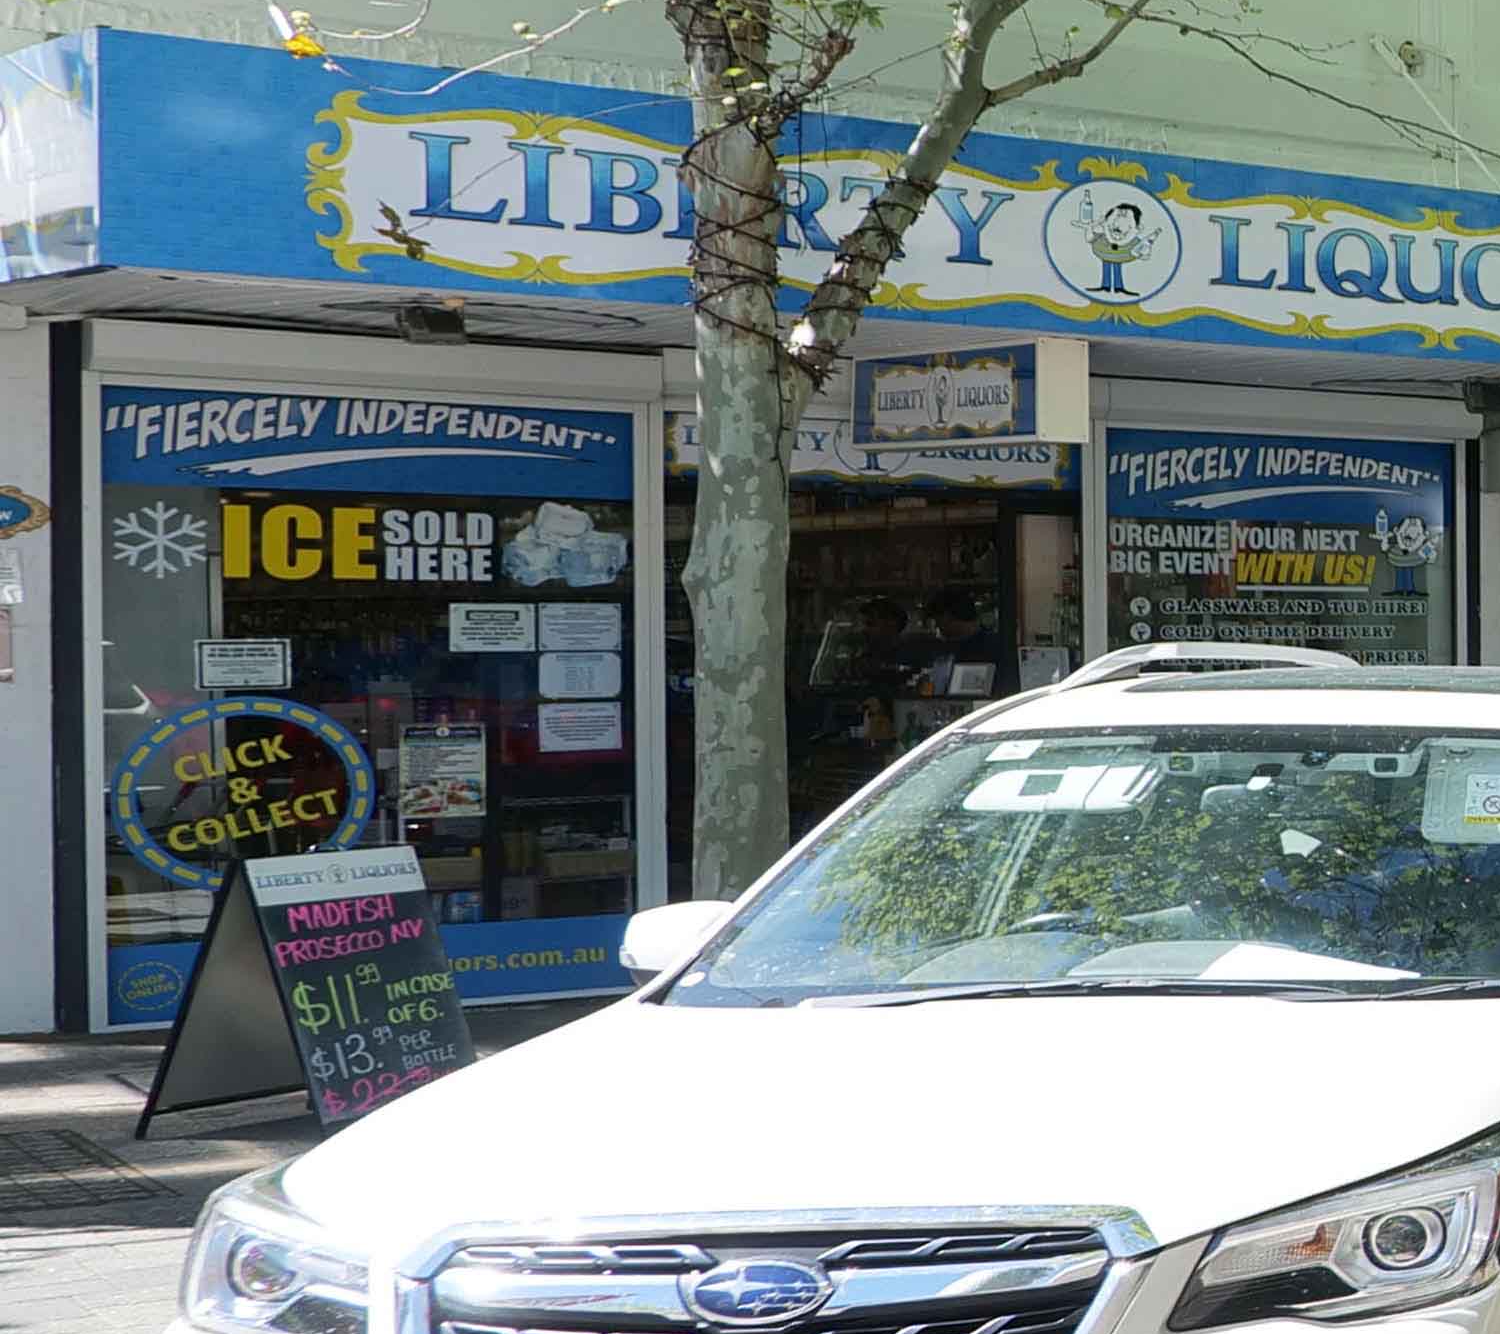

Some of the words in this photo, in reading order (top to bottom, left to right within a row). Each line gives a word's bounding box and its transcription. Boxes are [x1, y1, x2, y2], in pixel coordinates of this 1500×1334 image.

[877, 388, 925, 412] LIBERTY
[956, 384, 1011, 409] LIQUORS
[223, 503, 378, 581] ICE
[381, 509, 494, 547] SOLD
[1109, 521, 1232, 549] ORGANIZE
[1235, 525, 1298, 551] YOUR
[1302, 528, 1361, 552] NEXT
[384, 547, 494, 583] HERE
[1110, 550, 1152, 574] BIG
[1158, 551, 1233, 575] EVENT
[1236, 554, 1318, 585] WITH
[1323, 554, 1377, 585] US!
[1160, 598, 1279, 616] GLASSWARE
[1281, 599, 1326, 616] AND
[1328, 599, 1369, 616] TUB
[1372, 599, 1427, 616] HIRE!
[1160, 624, 1215, 639] COLD
[1307, 624, 1396, 640] DELIVERY
[1364, 648, 1427, 665] PRICES
[172, 733, 295, 783] CLICK
[228, 776, 263, 805] &
[166, 788, 339, 853] COLLECT
[256, 870, 324, 889] LIBERTY
[350, 860, 418, 881] LIQUORS
[286, 893, 396, 934] MADFISH
[273, 929, 385, 967] PROSECCO
[398, 1028, 435, 1052] PER
[401, 1043, 458, 1070] BOTTLE
